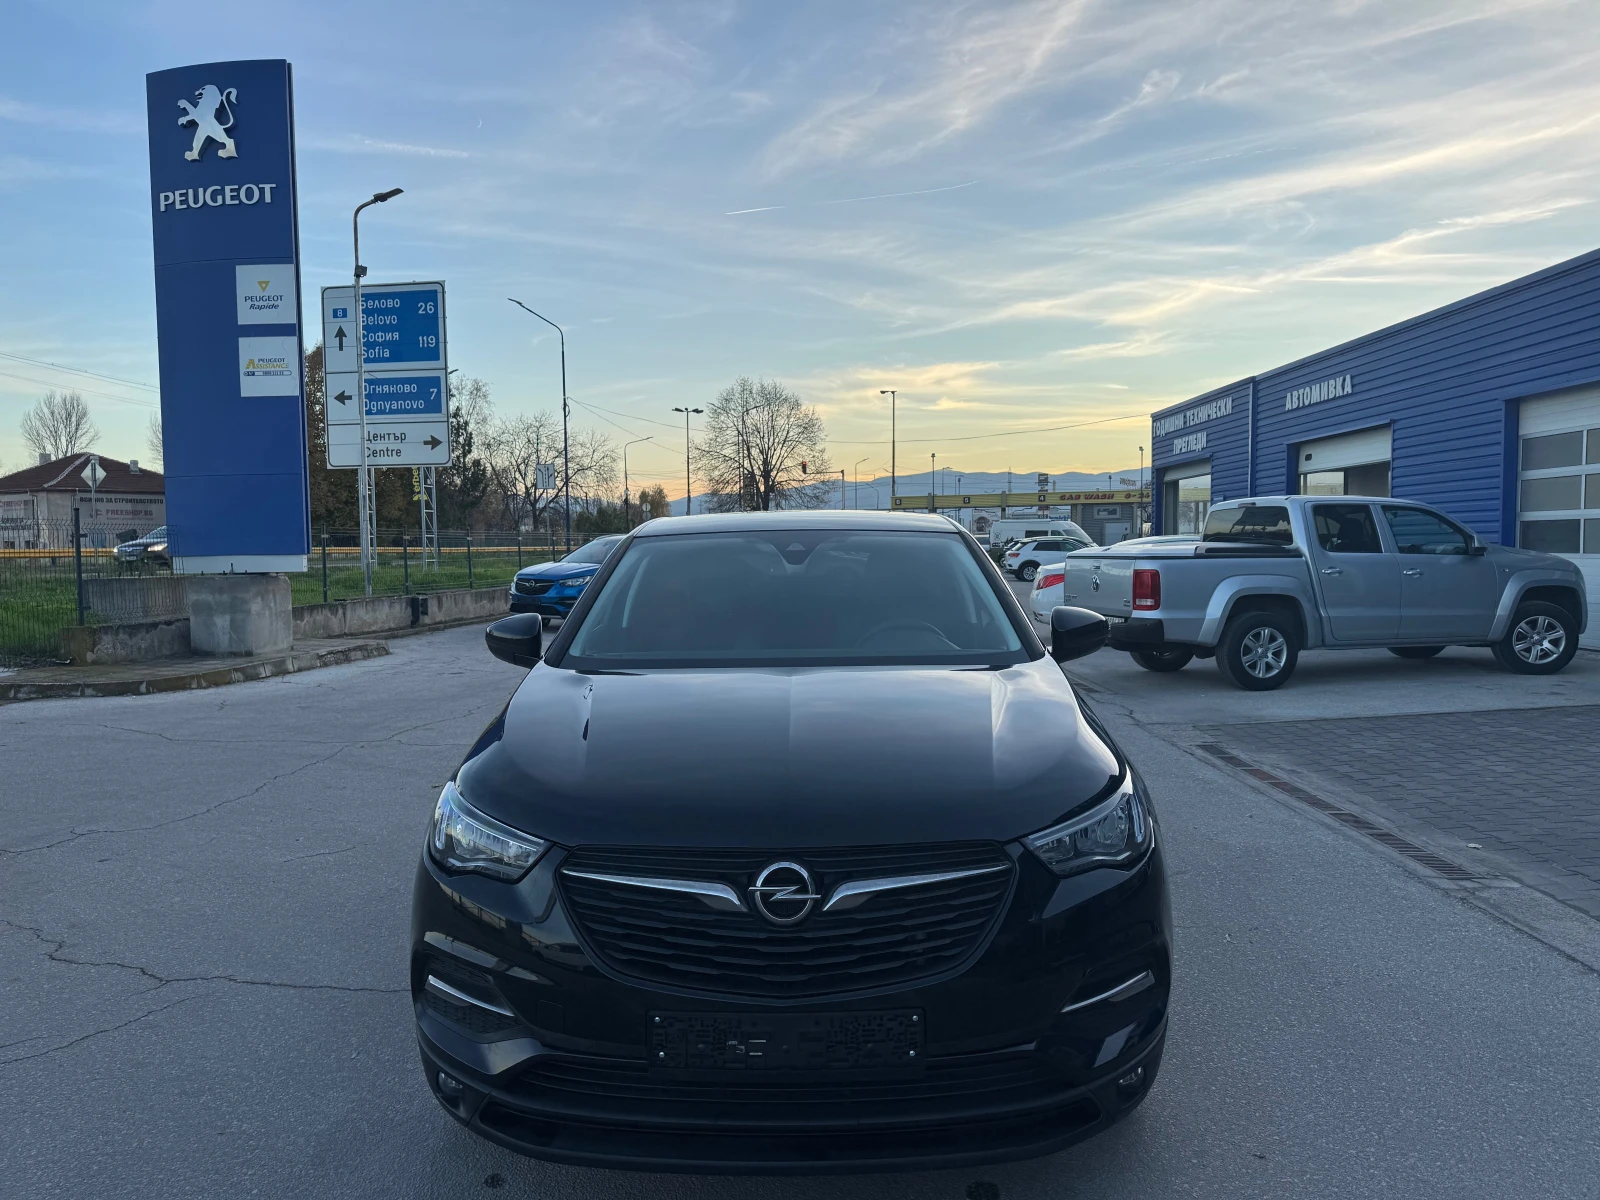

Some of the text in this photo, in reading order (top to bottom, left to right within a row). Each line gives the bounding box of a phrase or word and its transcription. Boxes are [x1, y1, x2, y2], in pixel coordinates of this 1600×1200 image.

[160, 184, 276, 212] PEUGEOT
[244, 295, 284, 303] PEUGEOT
[249, 303, 279, 311] Rapide
[361, 297, 435, 315] Белово 26
[337, 309, 343, 317] 8
[361, 313, 398, 325] Belovo
[361, 331, 436, 348] София 119
[362, 346, 390, 358] Sofia
[429, 388, 438, 400] 7
[1285, 374, 1352, 411] АВТОМИВКА
[1153, 396, 1233, 437] ГОДИШНИ ТЕХНИЧЕСКИ
[1173, 430, 1207, 455] ПРЕГЛЕДИ
[411, 466, 421, 493] efbe
